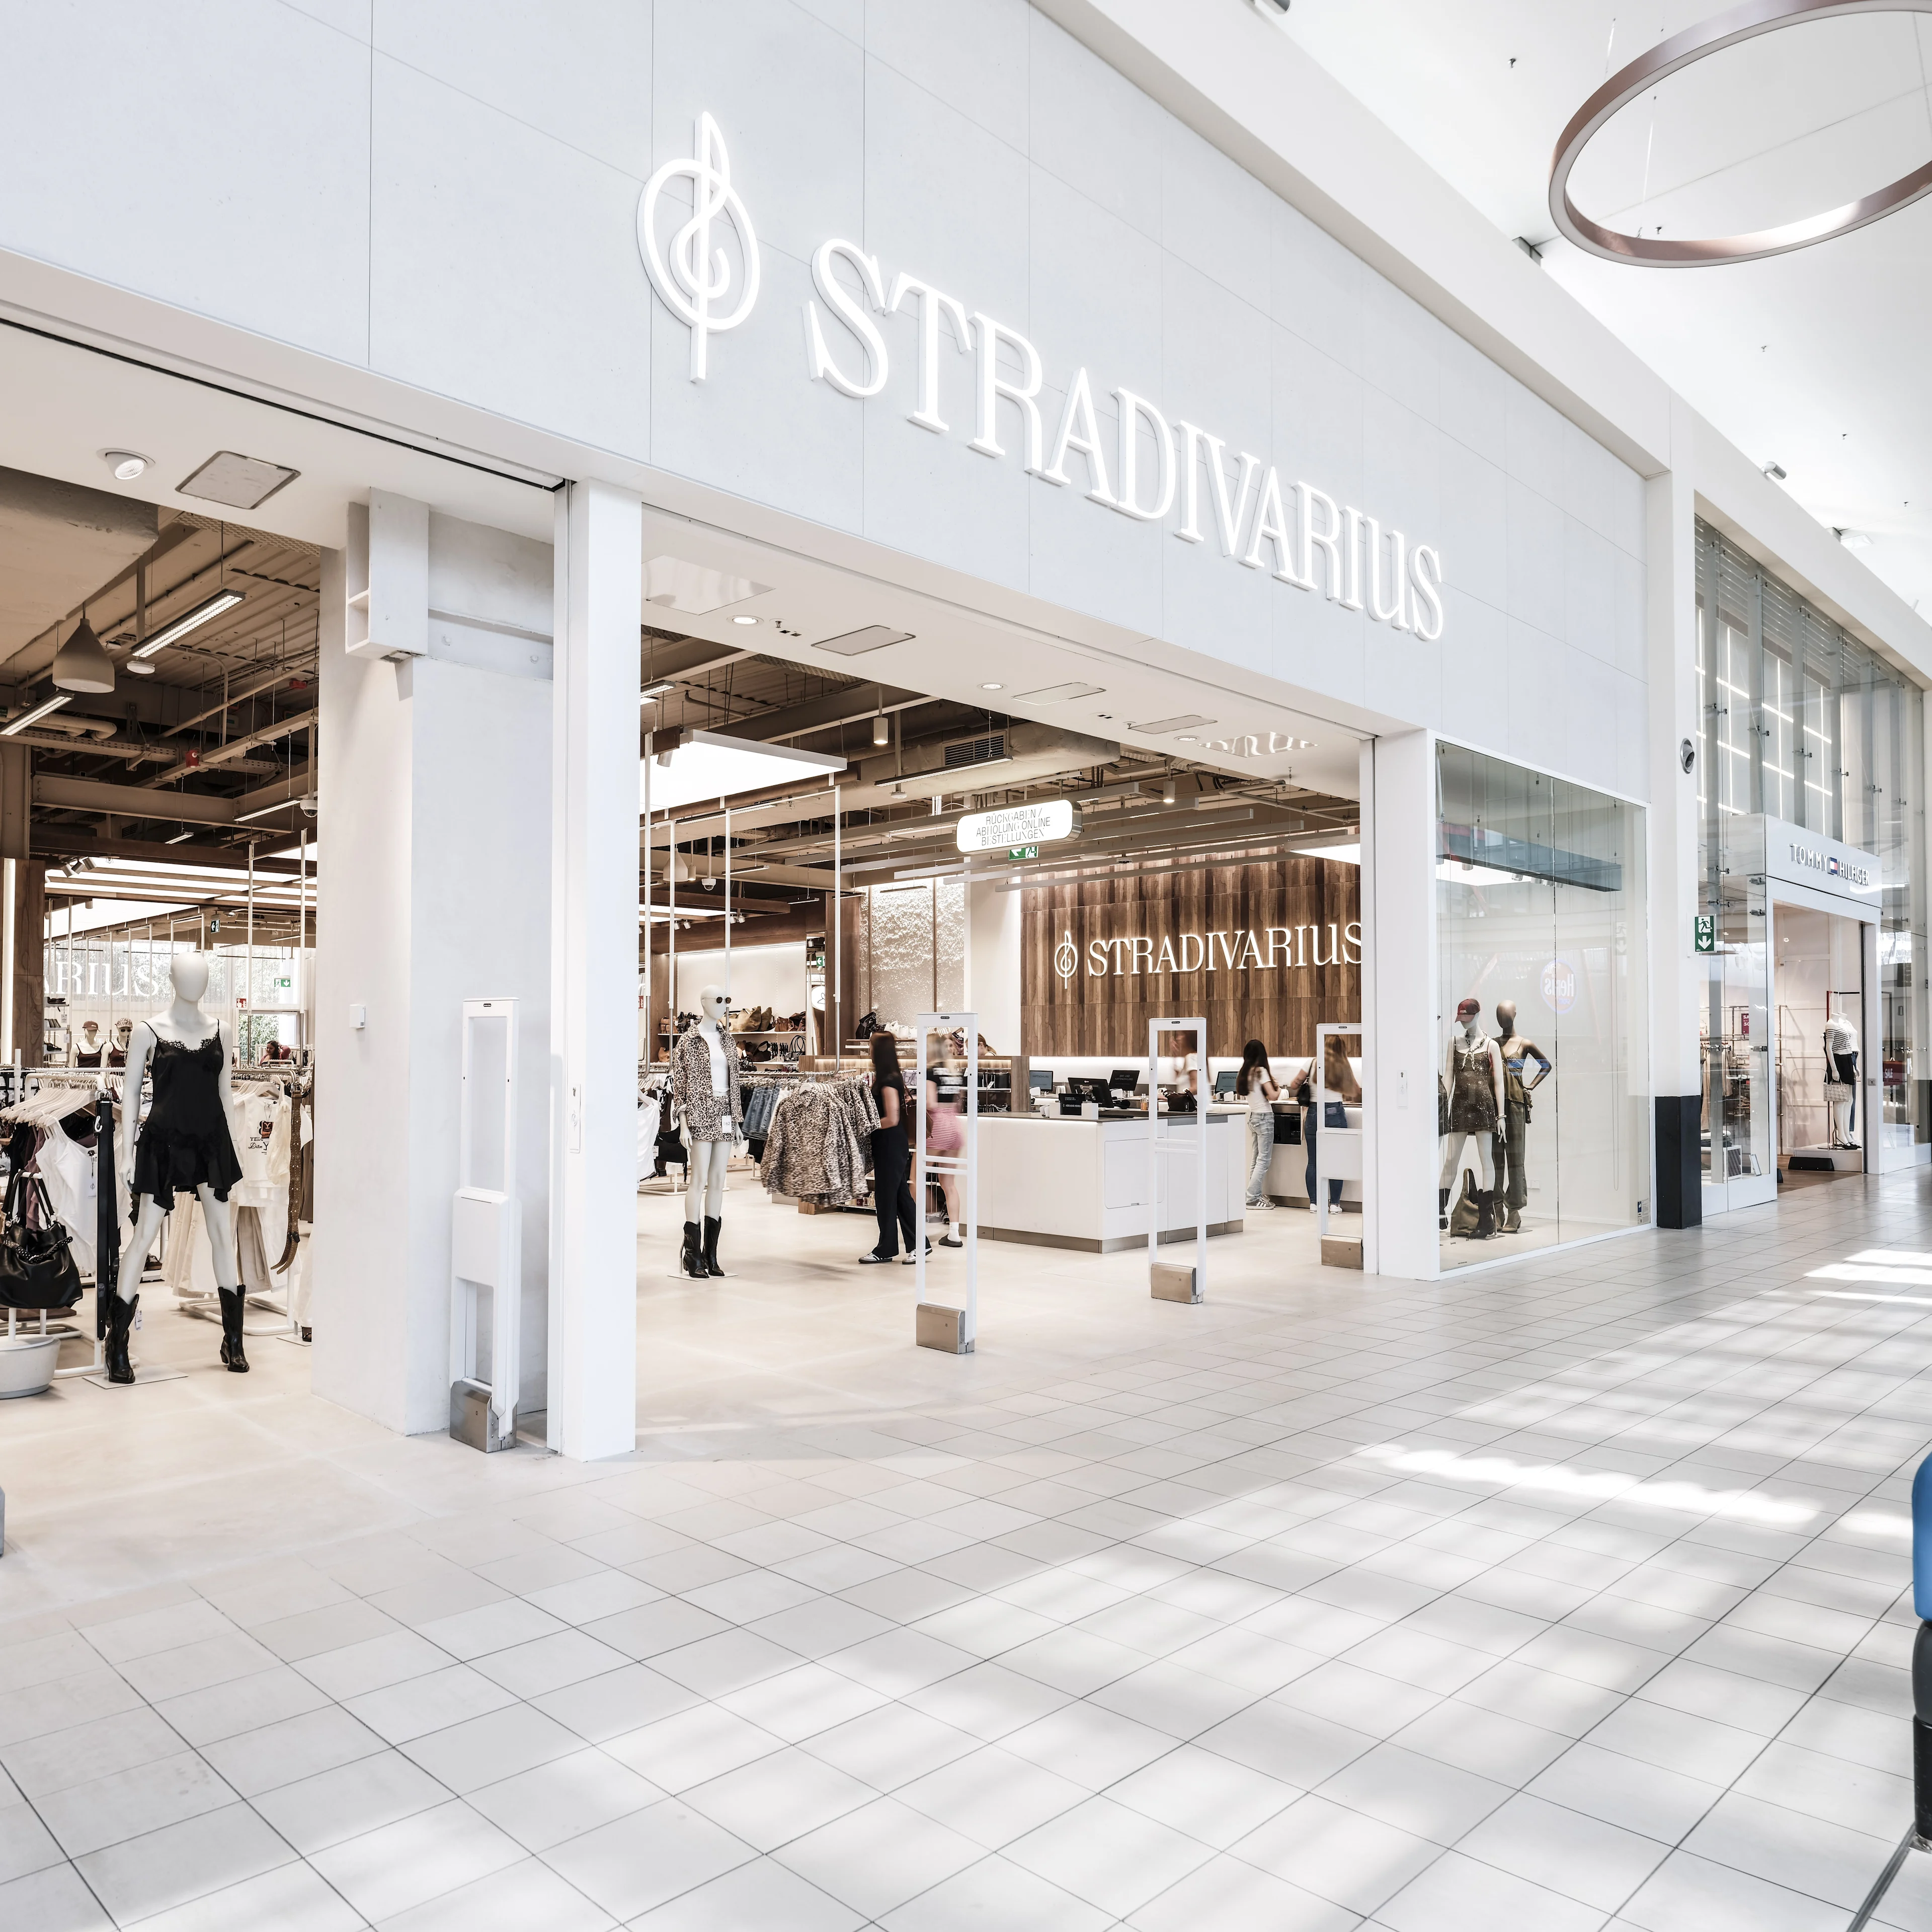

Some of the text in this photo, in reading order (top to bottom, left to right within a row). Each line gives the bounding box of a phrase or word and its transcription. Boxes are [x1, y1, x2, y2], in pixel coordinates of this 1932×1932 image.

[801, 237, 1444, 641] STRADIVARIUS
[1021, 817, 1051, 829] ONLINE
[1790, 843, 1870, 886] TOMMY HILFIGER
[1087, 922, 1361, 977] STRADIVARIUS
[1885, 1068, 1893, 1079] SALE
